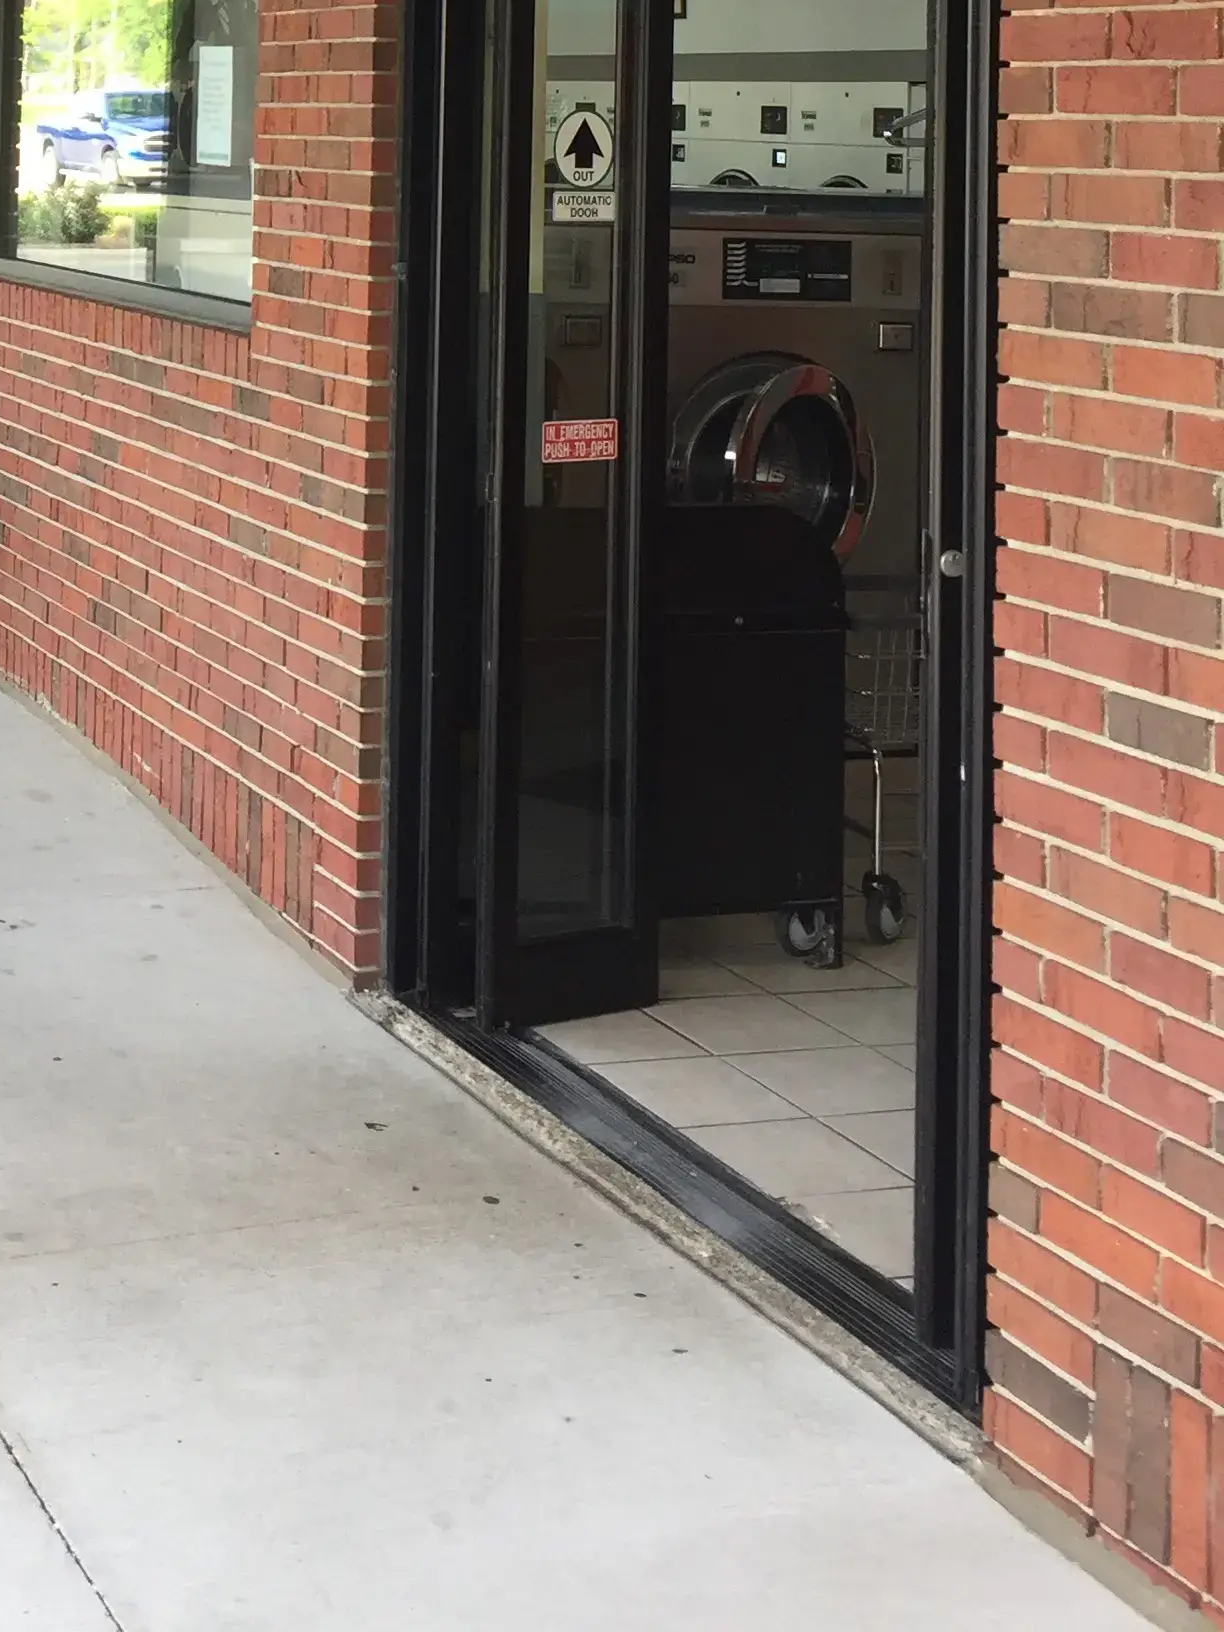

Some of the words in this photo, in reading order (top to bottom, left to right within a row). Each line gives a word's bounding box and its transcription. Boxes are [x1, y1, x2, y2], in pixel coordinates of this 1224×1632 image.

[573, 171, 595, 182] OUT
[557, 195, 612, 206] AUTOMATIC
[570, 208, 599, 218] DOOR
[545, 425, 556, 441] IN
[560, 423, 614, 441] EMERGENCY
[545, 442, 570, 458] PUSH
[574, 441, 586, 457] TO
[591, 440, 614, 457] OPEN
